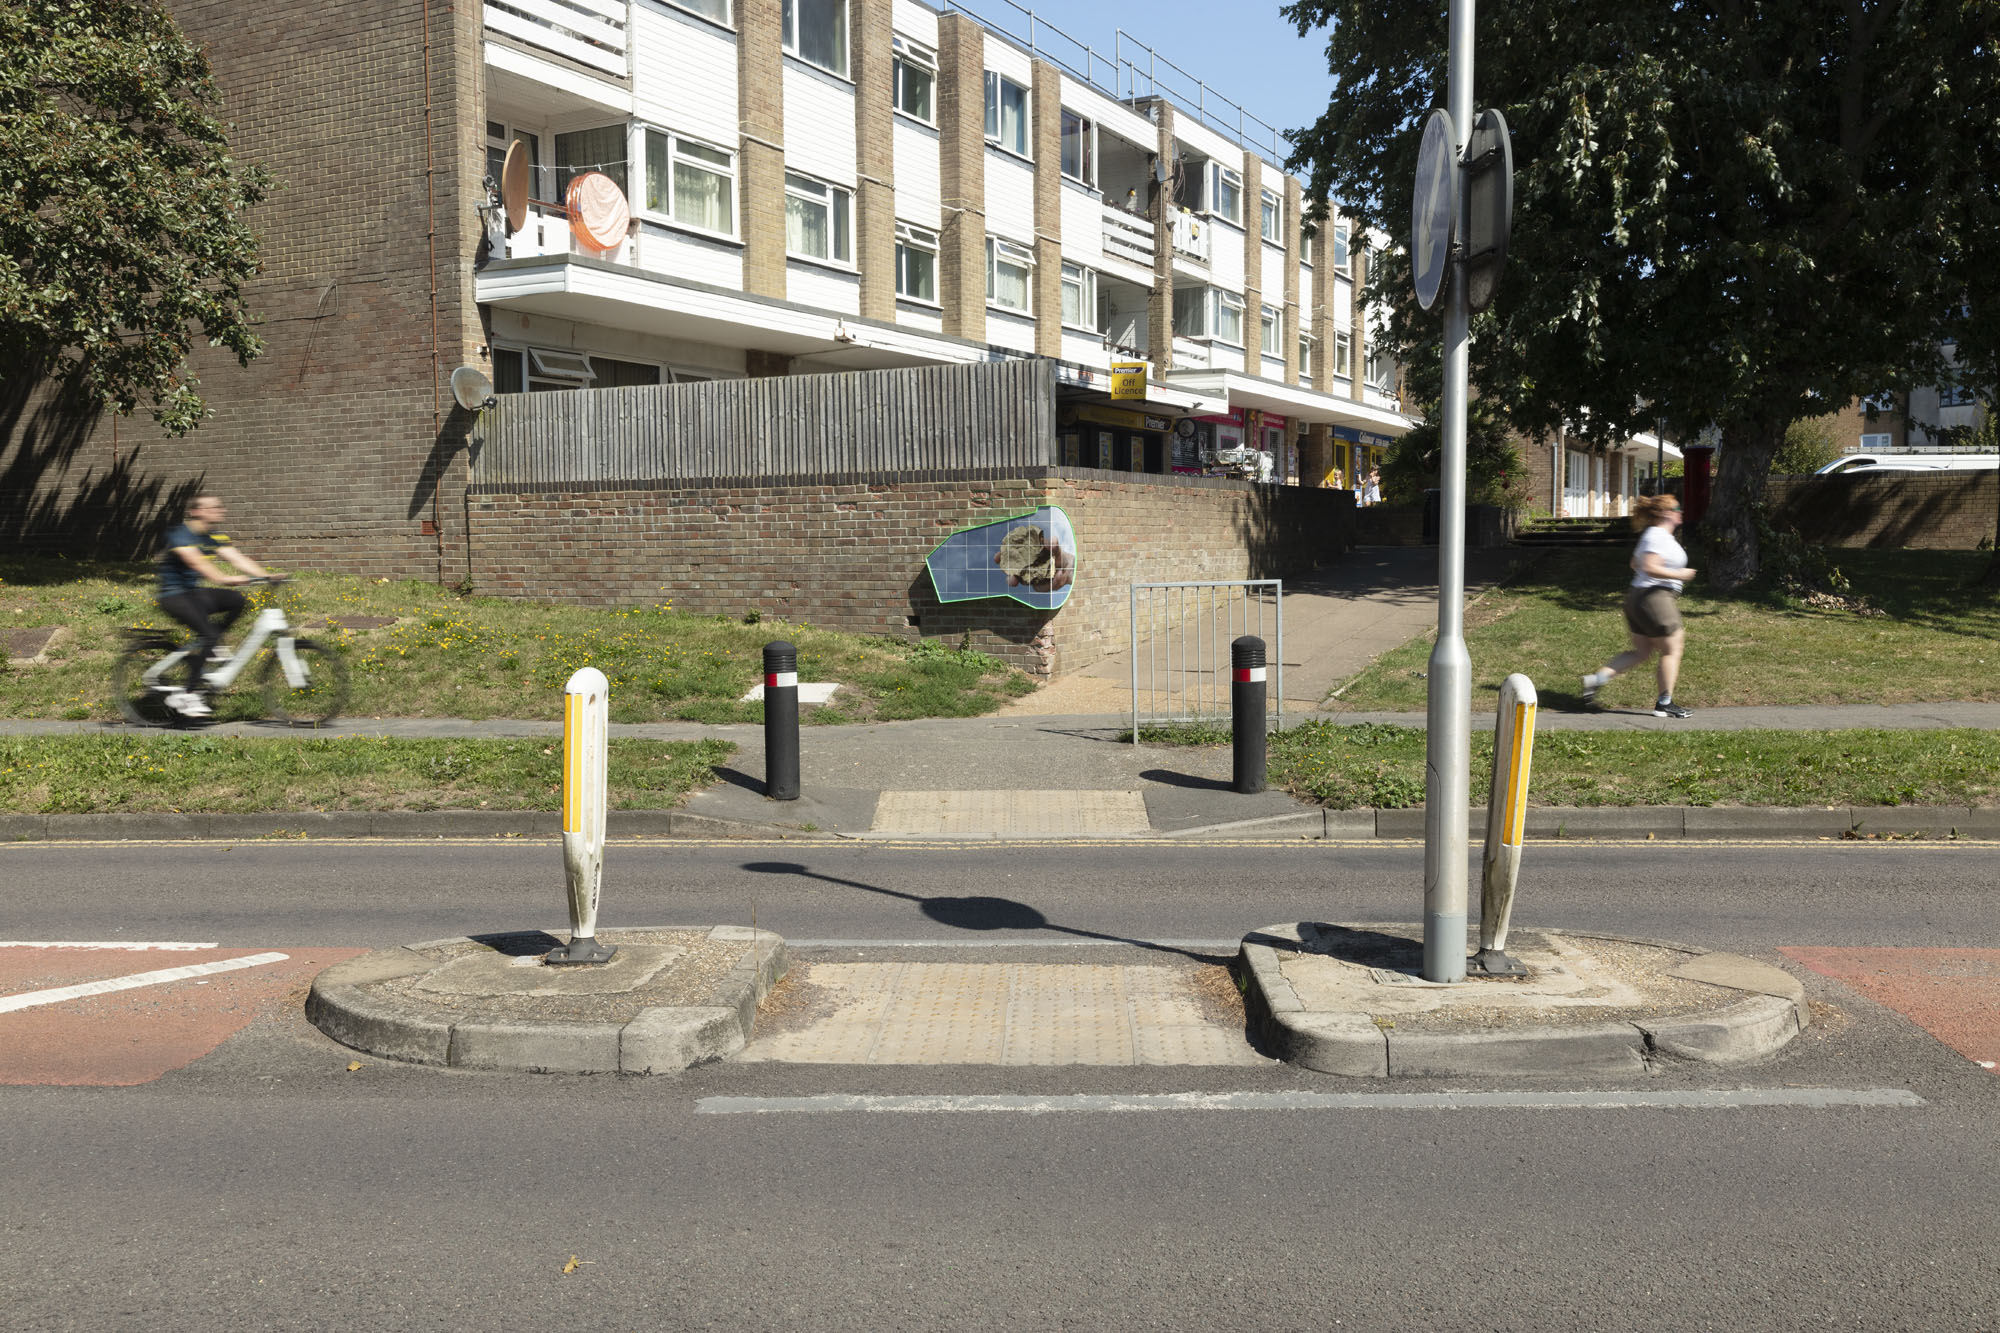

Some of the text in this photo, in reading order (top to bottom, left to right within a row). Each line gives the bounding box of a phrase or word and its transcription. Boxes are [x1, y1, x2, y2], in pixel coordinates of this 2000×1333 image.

[1122, 378, 1136, 387] Off
[1114, 386, 1144, 395] Licence
[1145, 416, 1166, 430] Premier
